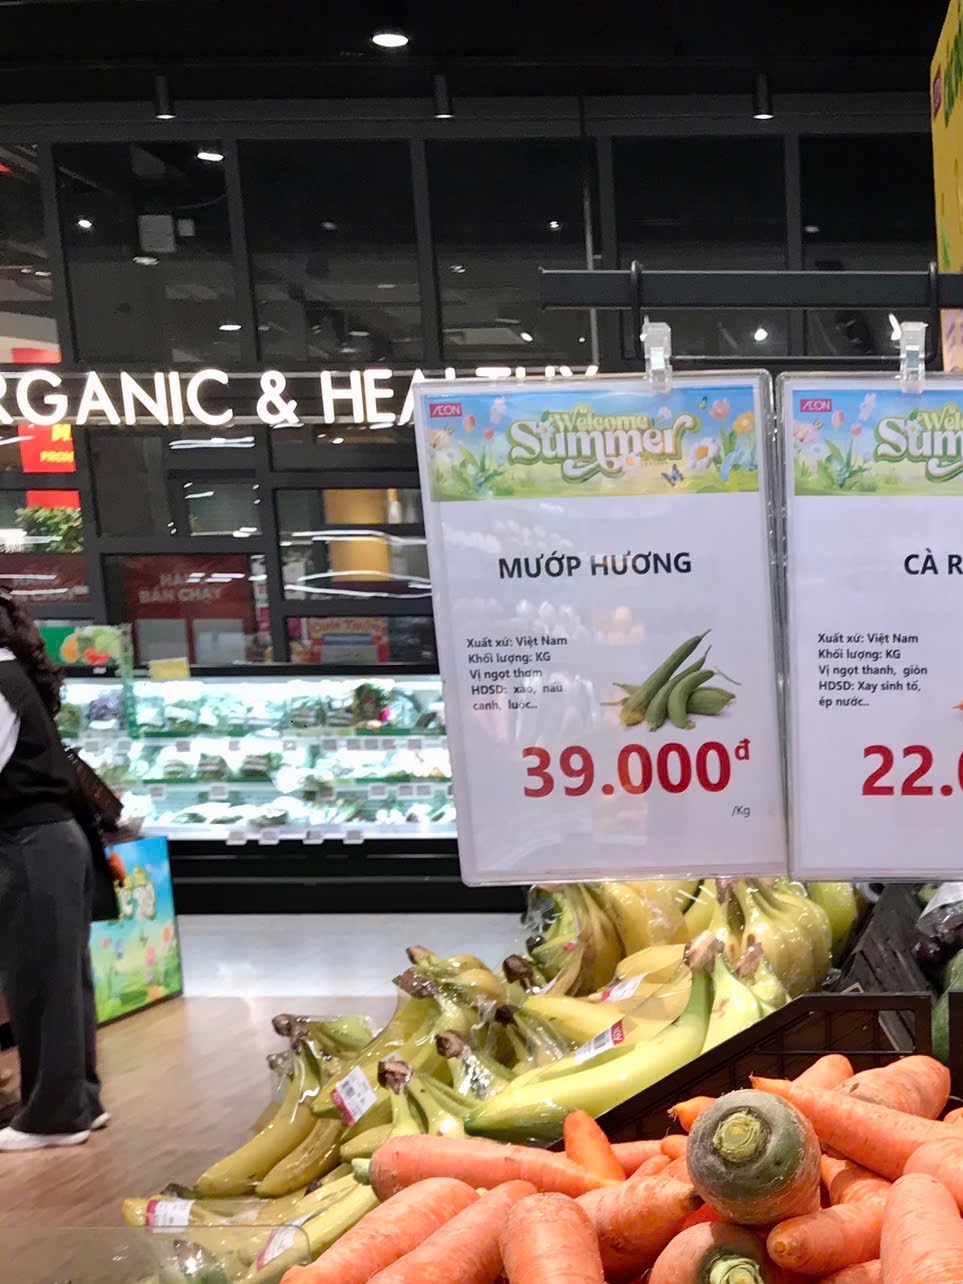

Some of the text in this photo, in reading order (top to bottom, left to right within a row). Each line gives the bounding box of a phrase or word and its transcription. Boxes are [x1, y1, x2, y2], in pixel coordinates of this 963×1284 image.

[256, 370, 300, 425] &
[550, 405, 650, 430] Welcome
[509, 415, 695, 483] Summer
[498, 550, 692, 579] MƯỚP HƯƠNG
[904, 548, 939, 576] CÀ
[466, 636, 567, 648] Xuất xứ: Việt Nam
[818, 632, 918, 645] Xuất xứ: Việt Nam
[468, 652, 551, 665] Khối lượng: KG
[818, 649, 901, 661] Khối lượng: KG
[469, 668, 542, 681] Vị ngọt thơm
[818, 665, 928, 677] Vị ngọt thanh, giòn
[471, 685, 508, 695] HDSD:
[819, 680, 921, 693] HDSD: Xay sinh tố,
[473, 700, 502, 711] canh,
[818, 696, 832, 708] ép
[731, 805, 751, 817] /Kg
